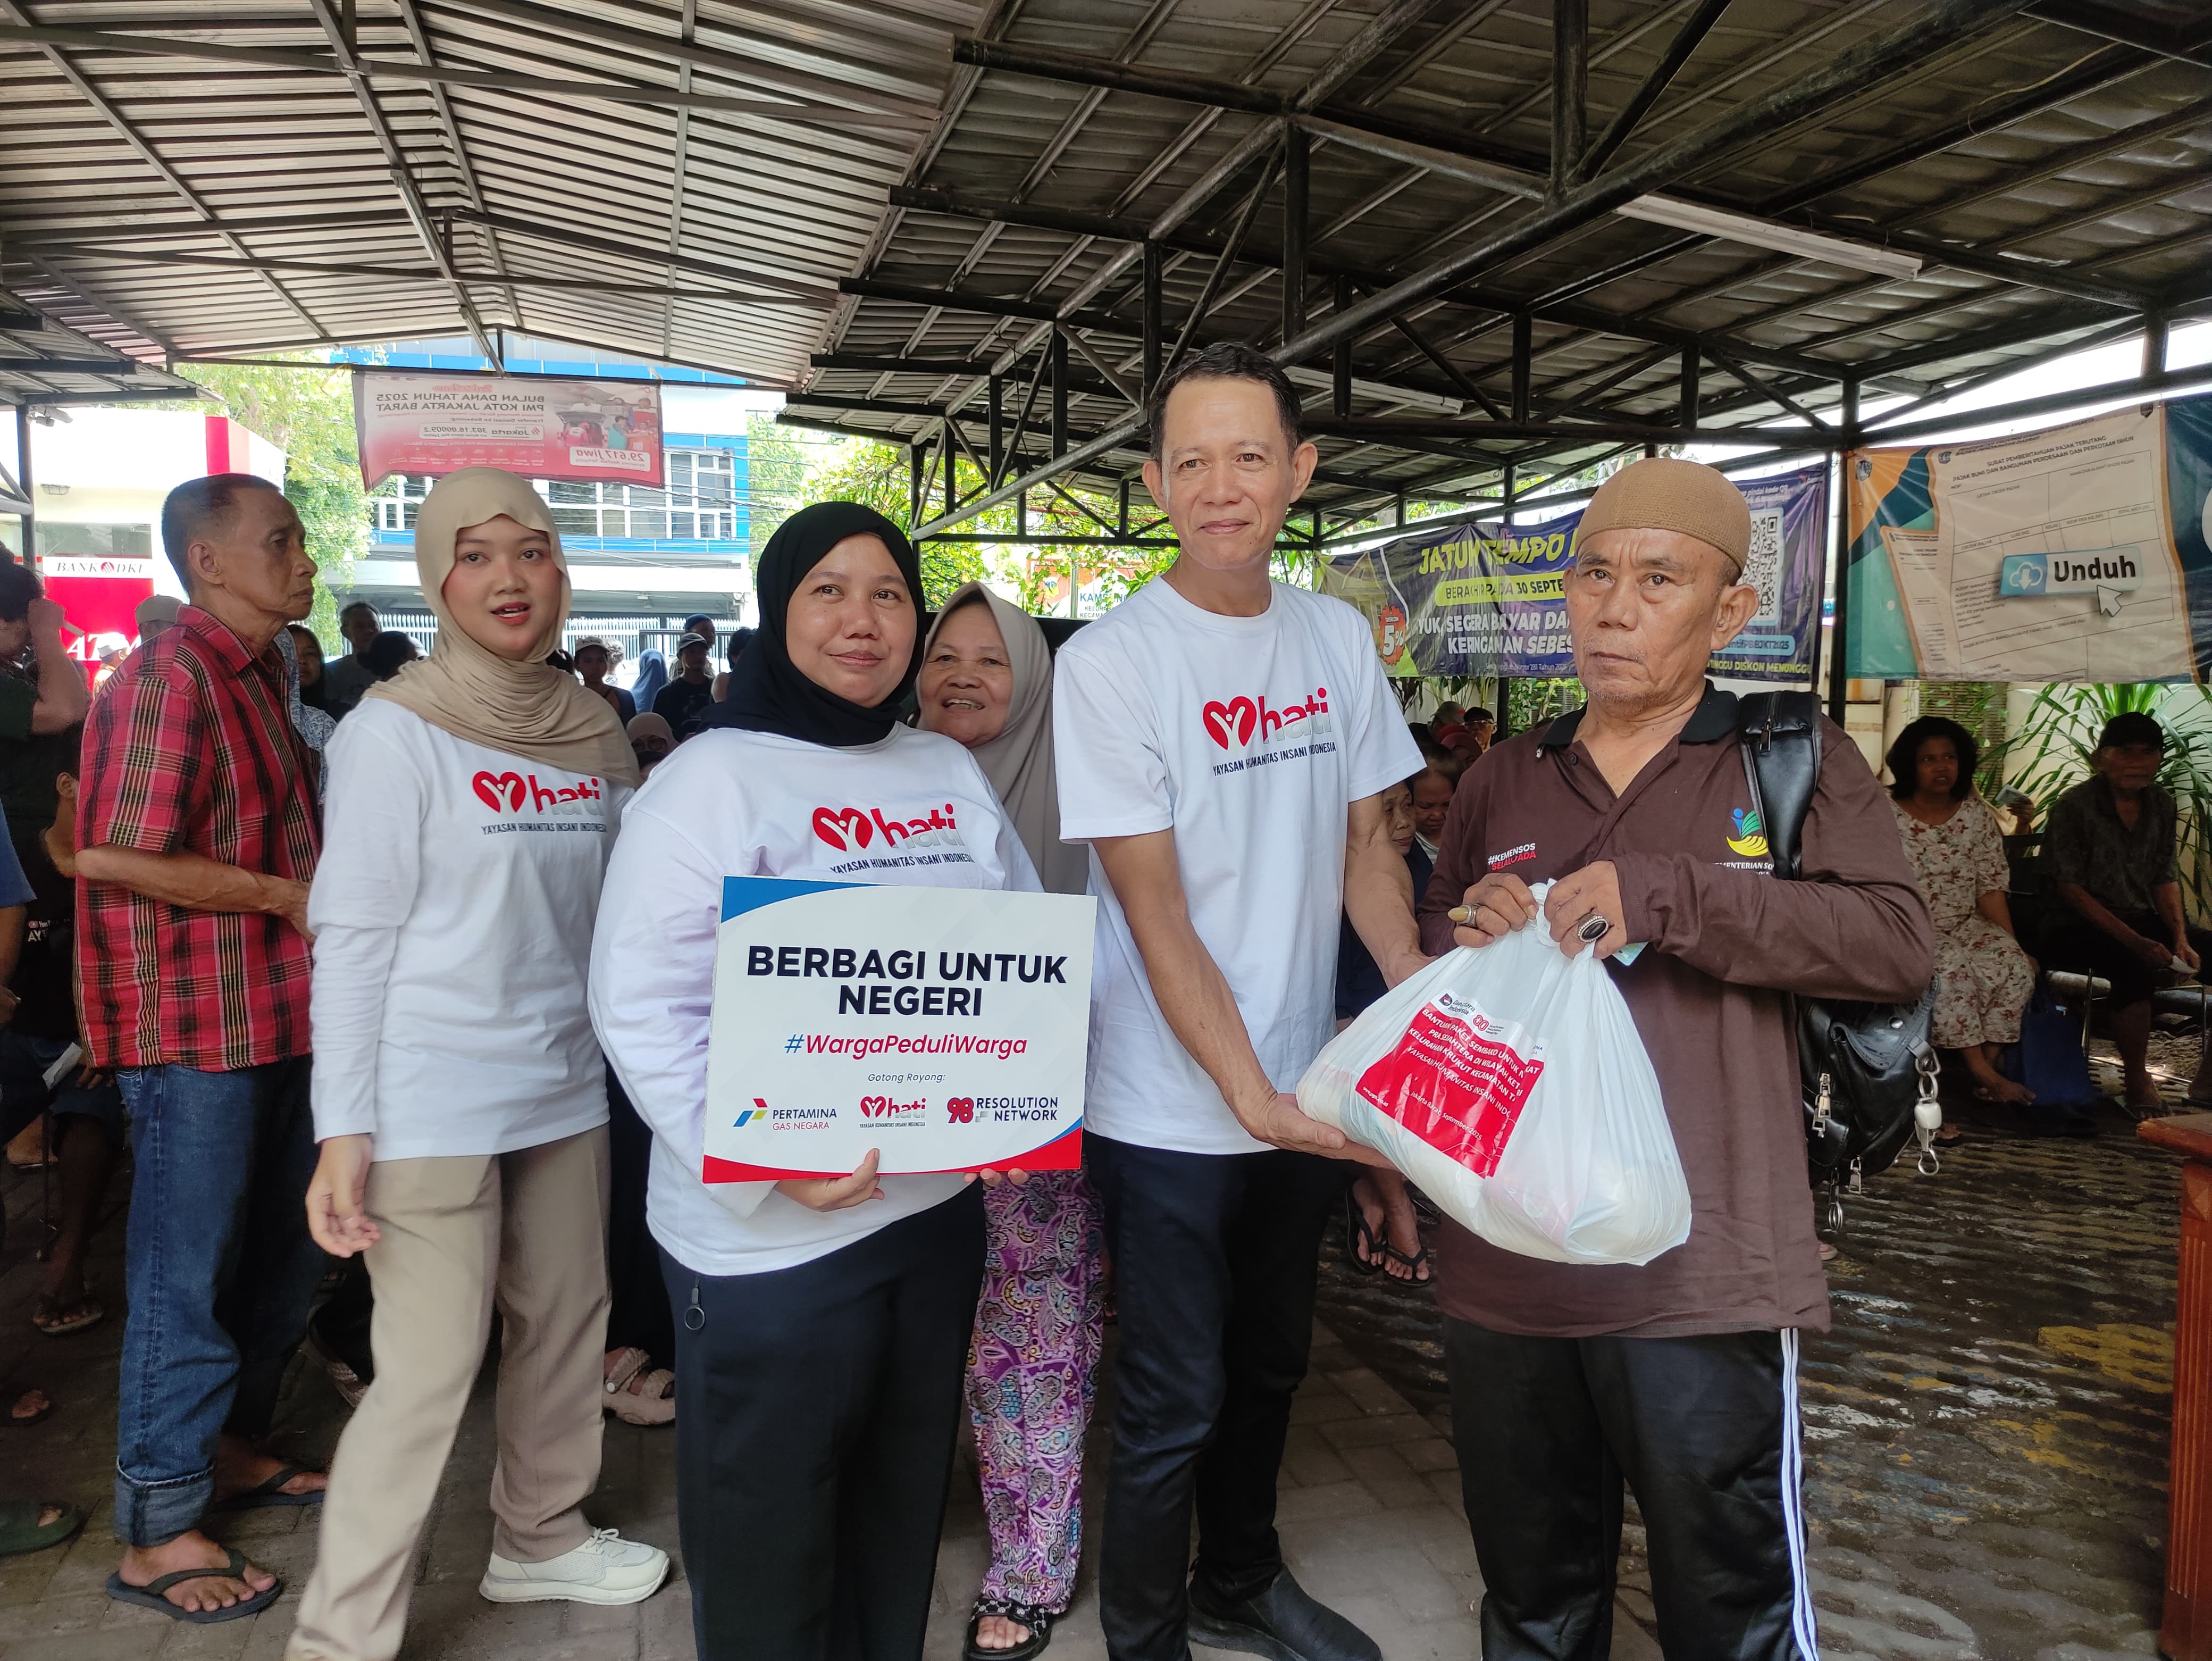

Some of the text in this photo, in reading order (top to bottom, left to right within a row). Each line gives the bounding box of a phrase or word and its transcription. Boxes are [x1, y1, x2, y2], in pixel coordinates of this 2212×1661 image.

[1987, 458, 2005, 467] SURAT
[2006, 446, 2055, 462] PEMBERITAHUAN
[2074, 435, 2107, 447] TERUTANG
[1999, 460, 2032, 472] BANGUNAN
[2033, 452, 2068, 464] PERDESAAN
[2083, 440, 2116, 452] PERKOTAAN
[2116, 436, 2134, 445] TAHUN
[1481, 533, 1566, 565] TEMPO
[57, 562, 143, 573] BANK DKI
[2053, 555, 2138, 583] Unduh
[1516, 582, 1528, 595] 30
[1530, 579, 1564, 594] SEPTE
[1446, 613, 1489, 633] SEGERA
[1490, 611, 1541, 633] BAYAR
[1544, 611, 1571, 630] DA
[1383, 625, 1404, 657] 5%
[1526, 635, 1573, 655] SEBES
[1734, 661, 1765, 672] DISKON
[1257, 687, 1332, 745] hati
[1212, 741, 1337, 777] YAYASAN HUMANITAS INSANI INDONESIA
[527, 774, 604, 816] hati
[481, 823, 517, 835] YAYASAN
[869, 803, 966, 849] hati
[830, 858, 870, 874] YAYASAN
[872, 856, 916, 870] HUMANITAS
[915, 853, 943, 866] INSANI
[1487, 842, 1536, 865] #KEMENSOS
[747, 945, 1069, 984] BERBAGI UNTUK
[838, 984, 983, 1016] NEGERI
[1472, 1014, 1489, 1032] 80
[784, 1033, 1028, 1061] #WargaPeduliWarga
[1421, 1008, 1451, 1031] BANTUAN
[1449, 1024, 1471, 1042] PAKET
[1468, 1040, 1498, 1056] SEMBAKO
[1497, 1050, 1520, 1074] UNTUK
[1406, 1045, 1436, 1067] YAYASAN
[1434, 1059, 1474, 1091] HUMANITAS
[1472, 1086, 1496, 1105] INSANI
[1407, 1028, 1444, 1053] KELURAHAN
[1442, 1048, 1472, 1074] KRUKUT
[1470, 1069, 1510, 1096] KECAMATAN
[1473, 1056, 1481, 1065] DI
[1481, 1058, 1509, 1079] WILAYAH
[868, 1073, 946, 1084] Gotong Royong:
[772, 1108, 837, 1120] PERTAMINA
[887, 1097, 926, 1119] hati
[947, 1097, 1058, 1124] 98 RESOLUTION
[994, 1109, 1058, 1122] NETWORK
[1411, 1090, 1483, 1141] Jakarta Barat, September 2025
[772, 1121, 830, 1131] GAS NEGARA
